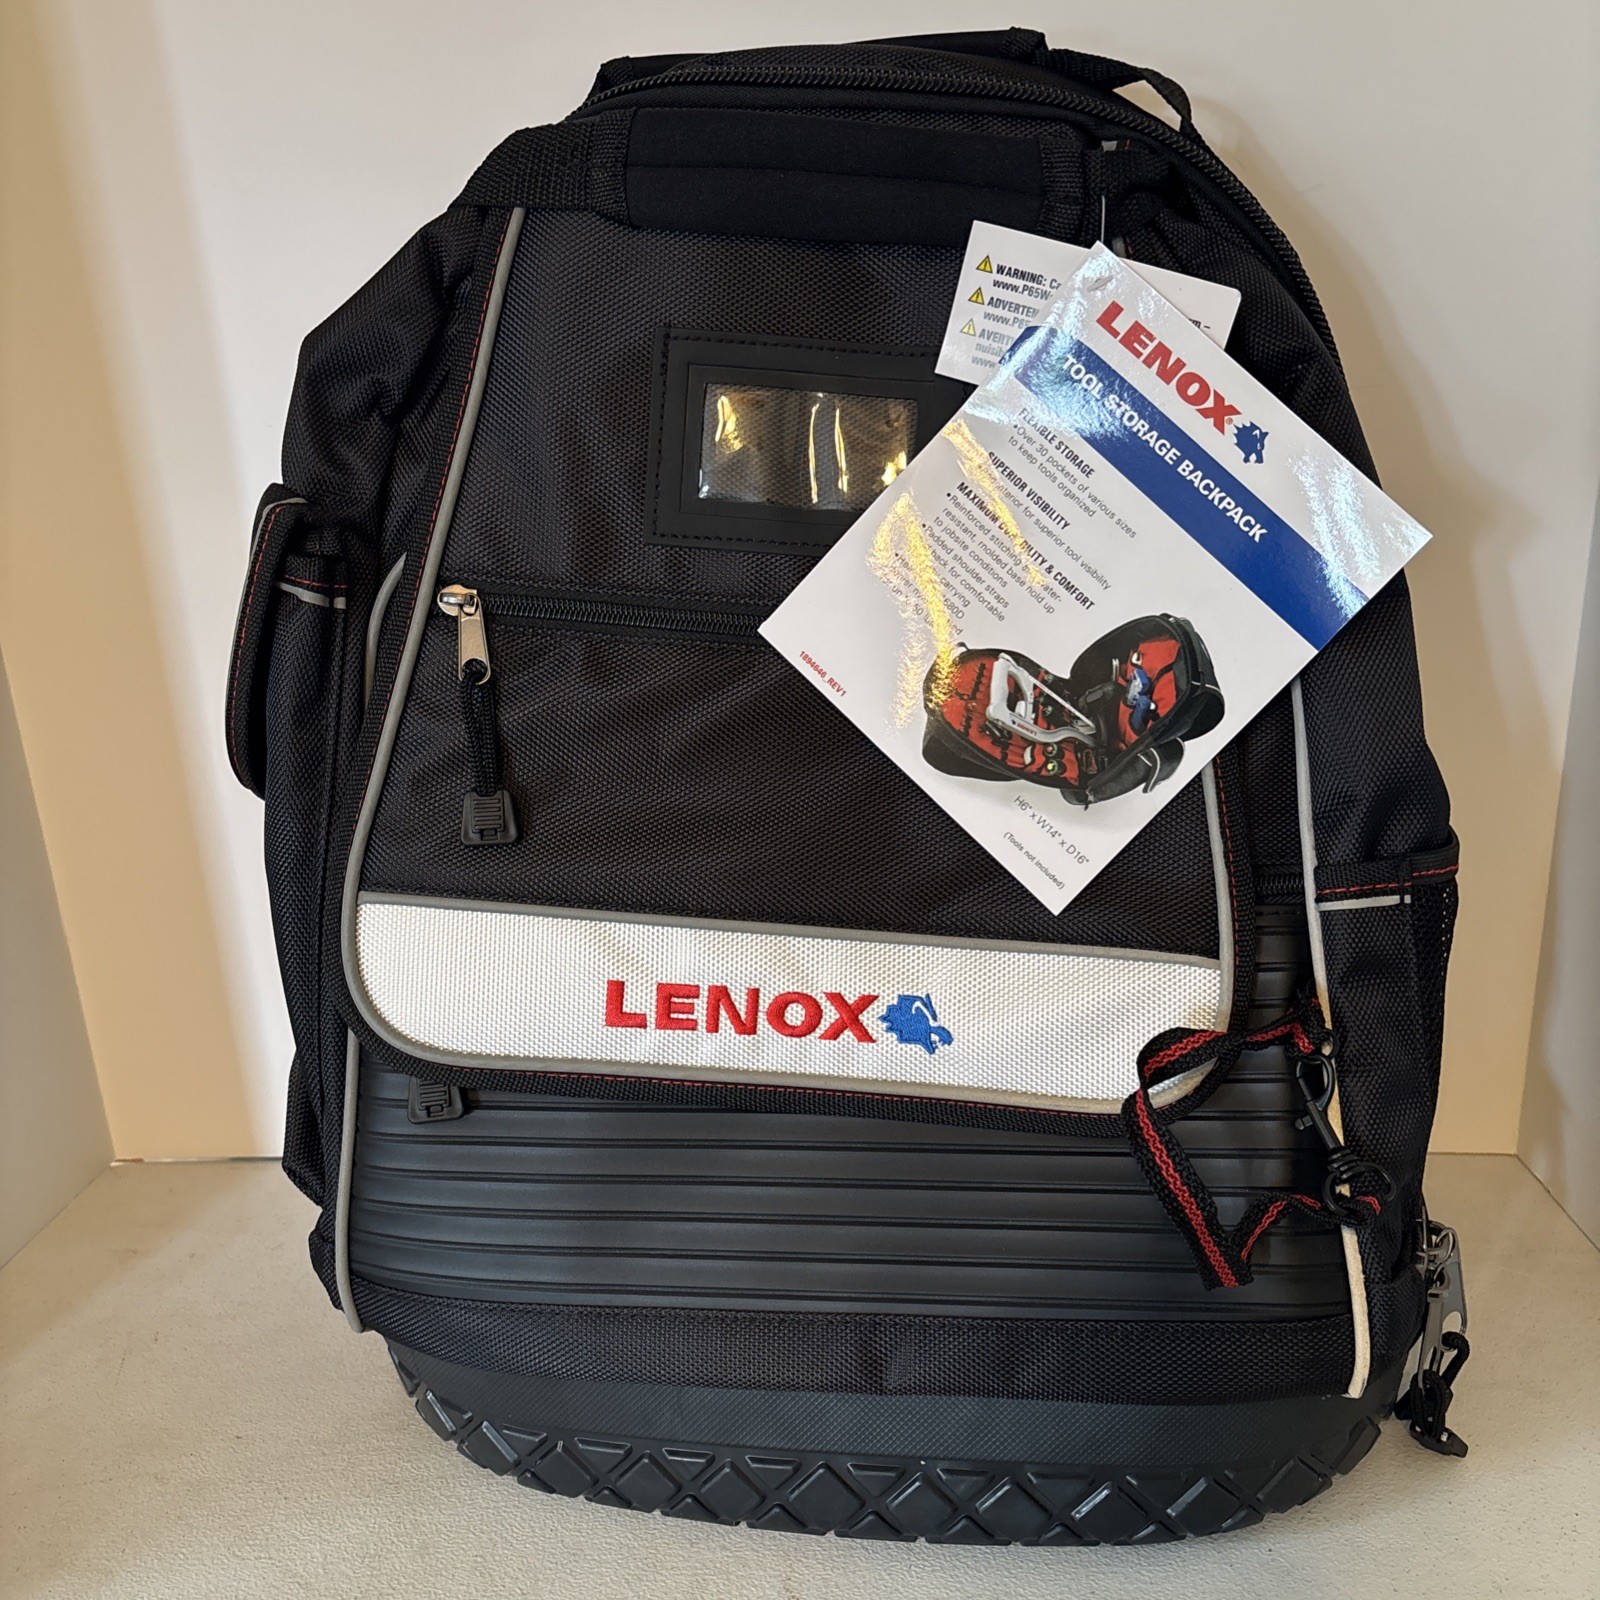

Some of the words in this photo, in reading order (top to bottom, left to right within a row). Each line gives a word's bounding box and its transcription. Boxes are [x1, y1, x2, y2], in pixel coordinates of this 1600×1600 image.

[995, 264, 1046, 285] WARNING:
[1007, 435, 1019, 447] to
[1016, 444, 1038, 465] keep
[1037, 462, 1058, 482] tools
[1056, 481, 1095, 517] organized
[1016, 426, 1036, 446] Over
[1034, 443, 1049, 457] 30
[1046, 455, 1078, 485] pockets
[1076, 481, 1089, 494] of
[1087, 492, 1116, 518] various
[1115, 517, 1136, 537] sizes
[1055, 441, 1094, 477] STORAGE
[1060, 355, 1107, 399] TOOL
[1102, 393, 1180, 465] STORAGE
[1176, 459, 1267, 542] BACKPACK
[985, 452, 1027, 491] SUPERIOR
[1025, 489, 1069, 530] VISIBILITY
[924, 526, 953, 554] Padded
[952, 553, 985, 584] shoulder
[983, 584, 1009, 609] straps
[933, 516, 944, 527] to
[942, 525, 969, 551] jobsite
[968, 549, 1008, 587] conditions
[941, 507, 978, 542] resistant,
[977, 540, 1008, 569] molded
[1006, 567, 1026, 586] base
[1041, 601, 1055, 615] up
[949, 495, 991, 534] Reinforced
[988, 533, 1023, 566] stitching
[1037, 578, 1063, 603] ater-
[957, 482, 1000, 522] MAXIMUM
[1044, 563, 1055, 575] &
[1053, 572, 1094, 610] COMFORT
[994, 481, 1023, 508] nterior
[1021, 505, 1036, 520] for
[1032, 518, 1065, 549] superior
[1064, 546, 1081, 561] tool
[1078, 560, 1111, 591] visibility
[911, 602, 925, 616] 50
[938, 576, 971, 607] carrying
[947, 565, 962, 580] for
[959, 577, 1006, 621] comfortable
[798, 651, 846, 697] 1894646_REV1
[1003, 831, 1024, 851] (Tools
[1022, 849, 1036, 862] not
[1034, 860, 1064, 889] included)
[1029, 811, 1037, 820] x
[1057, 839, 1067, 847] x
[605, 979, 879, 1044] LENOX
